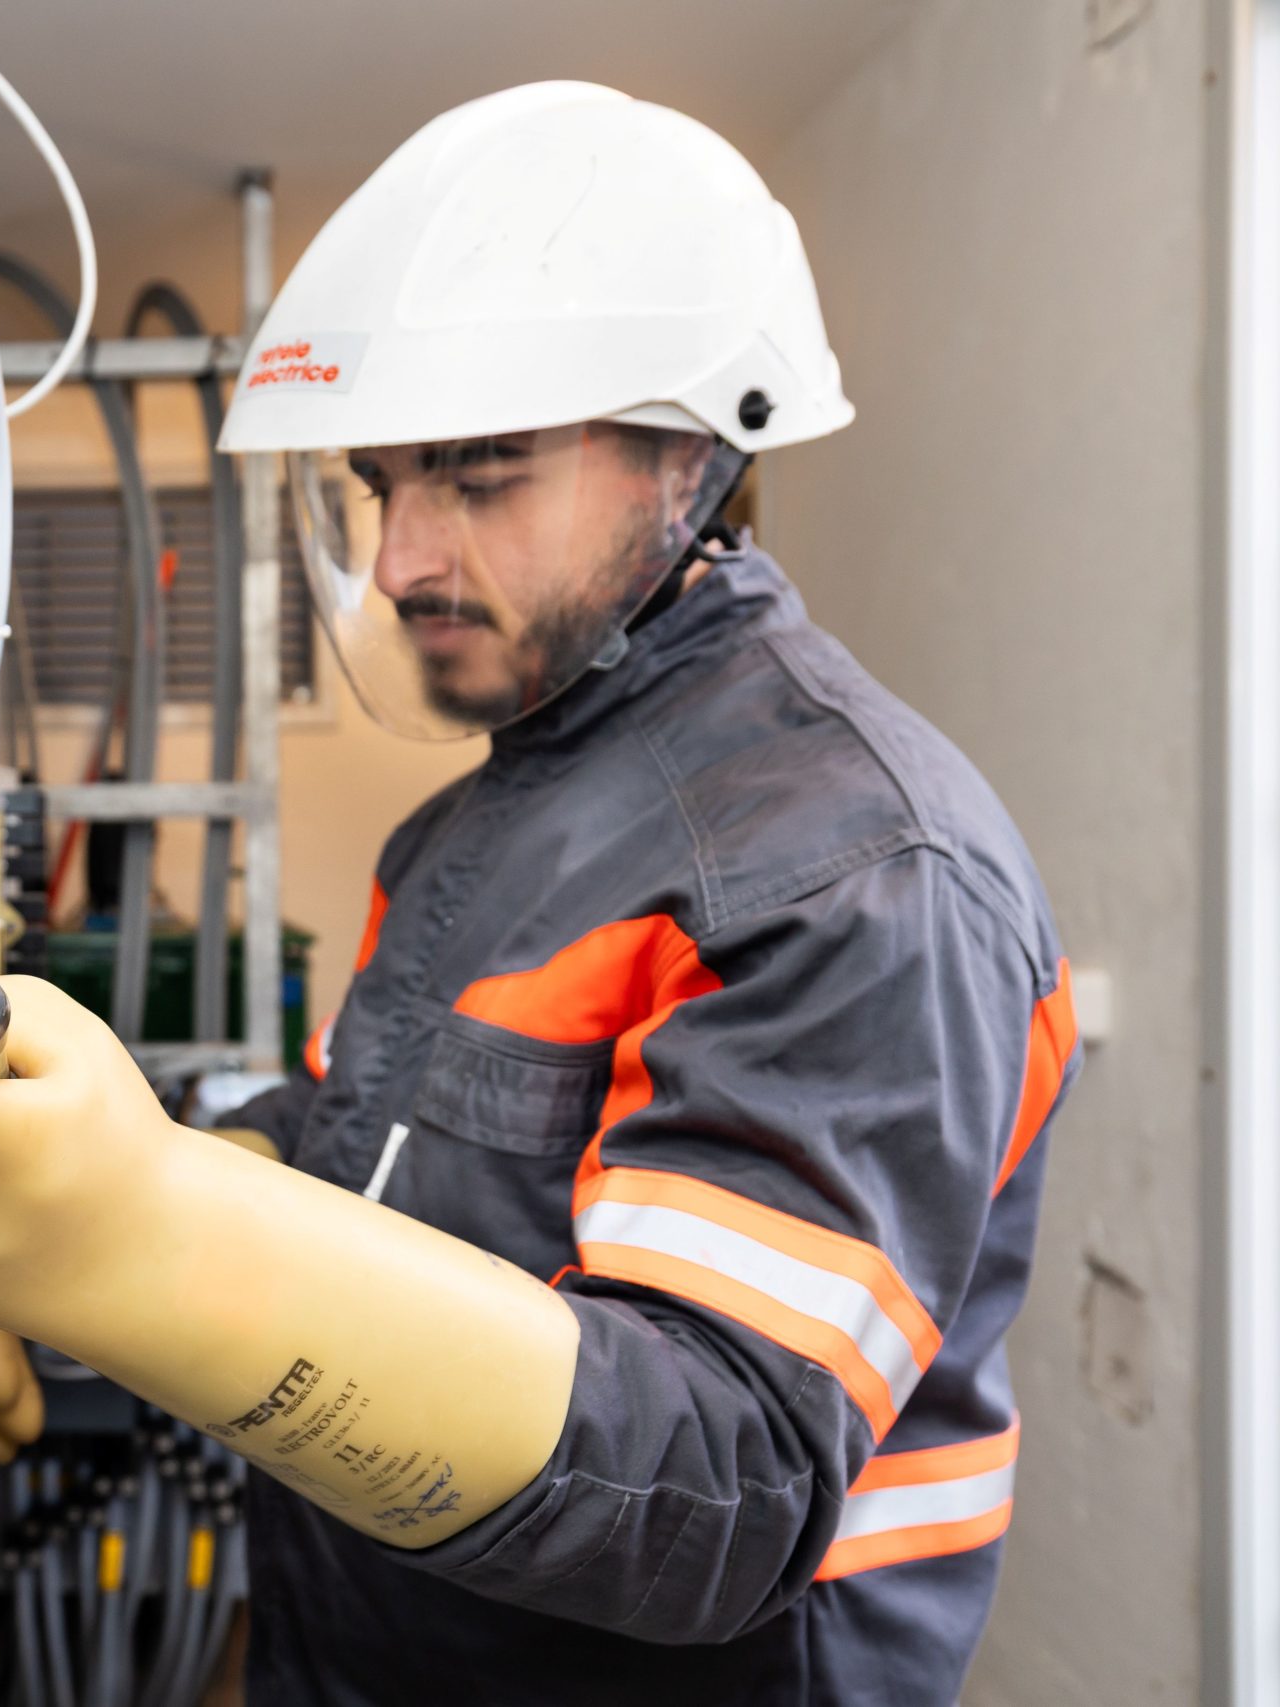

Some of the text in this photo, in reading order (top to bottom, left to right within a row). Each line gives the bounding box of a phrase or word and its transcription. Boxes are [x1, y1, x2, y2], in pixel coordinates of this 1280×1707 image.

[227, 1357, 315, 1433] PENTA
[274, 1378, 358, 1455] ELECTROVOLT
[281, 1367, 325, 1418] REGELTEX
[333, 1443, 364, 1465] 11
